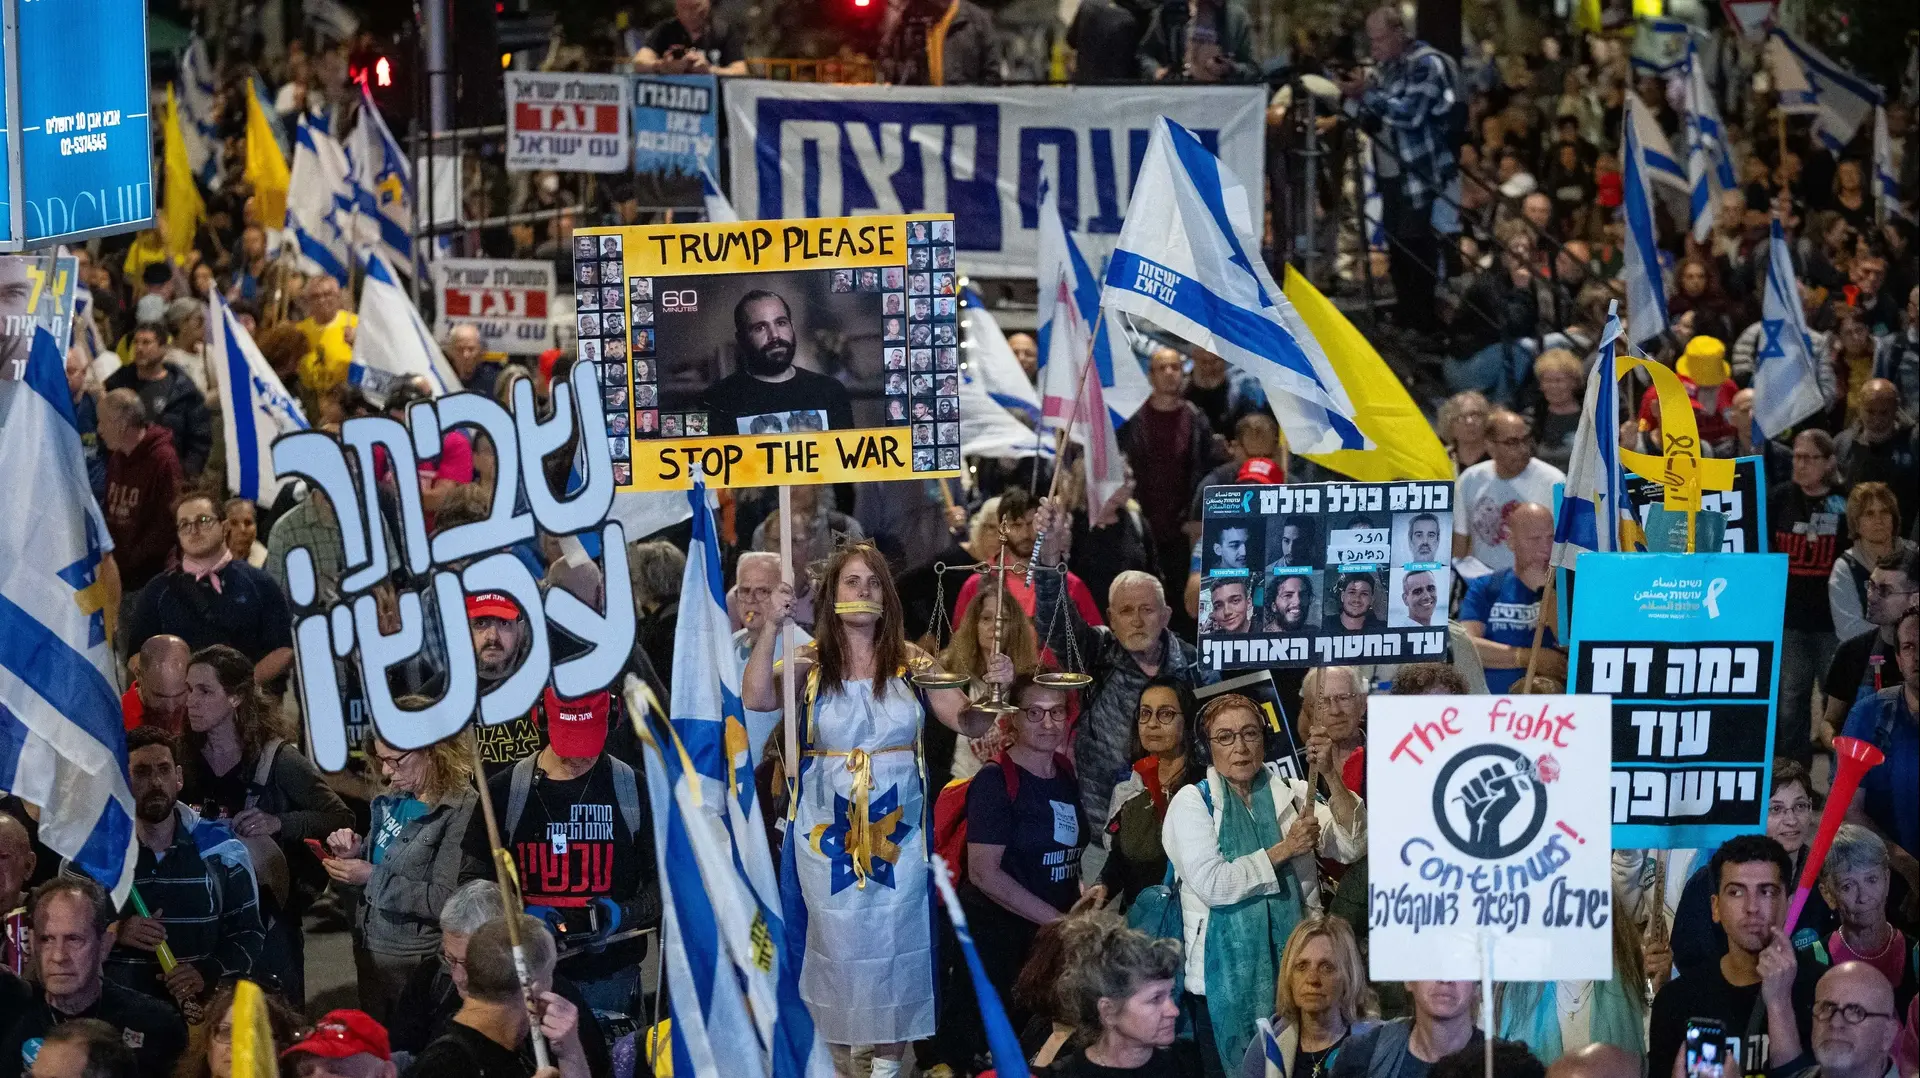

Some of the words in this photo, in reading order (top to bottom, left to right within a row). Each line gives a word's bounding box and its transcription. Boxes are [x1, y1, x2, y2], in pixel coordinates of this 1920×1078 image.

[513, 78, 561, 99] ישראל
[45, 115, 75, 134] ירושלים
[76, 112, 85, 130] 10
[528, 104, 597, 132] נגד
[514, 134, 582, 155] ישראל
[588, 138, 619, 157] עם
[779, 118, 978, 217] ינצח
[648, 228, 772, 265] TRUMP
[783, 225, 895, 263] PLEASE
[459, 289, 527, 317] נגד
[662, 289, 698, 307] 60
[662, 305, 698, 313] MINUTES
[517, 324, 546, 340] עם
[658, 444, 743, 485] STOP
[756, 440, 820, 474] THE
[835, 435, 905, 469] WAR
[271, 359, 616, 606] שביתה
[1260, 486, 1320, 514] כולם
[1327, 484, 1383, 512] כולל
[1389, 483, 1449, 511] כולם
[1354, 532, 1383, 544] חזר
[1652, 576, 1678, 588] نساء
[1679, 580, 1702, 588] נשים
[1633, 590, 1668, 601] يصنعن
[1669, 590, 1702, 599] עושות
[294, 521, 636, 773] עכשיו
[1202, 637, 1308, 671] האחרון!
[1315, 633, 1401, 662] החטוף
[1407, 631, 1444, 655] עד
[1591, 647, 1654, 694] דם
[1666, 647, 1760, 694] כמה
[560, 713, 577, 722] אשם
[578, 712, 593, 721] אתה
[1389, 706, 1464, 766] The
[1488, 697, 1577, 748] fight
[1631, 711, 1711, 757] עוד
[1611, 771, 1757, 823] יישפך
[570, 804, 613, 822] מחזירים
[546, 822, 582, 840] הביתה
[584, 823, 614, 840] אותם
[517, 842, 614, 893] עכשיו
[1042, 850, 1065, 865] שווה
[1543, 876, 1609, 930] ישראל
